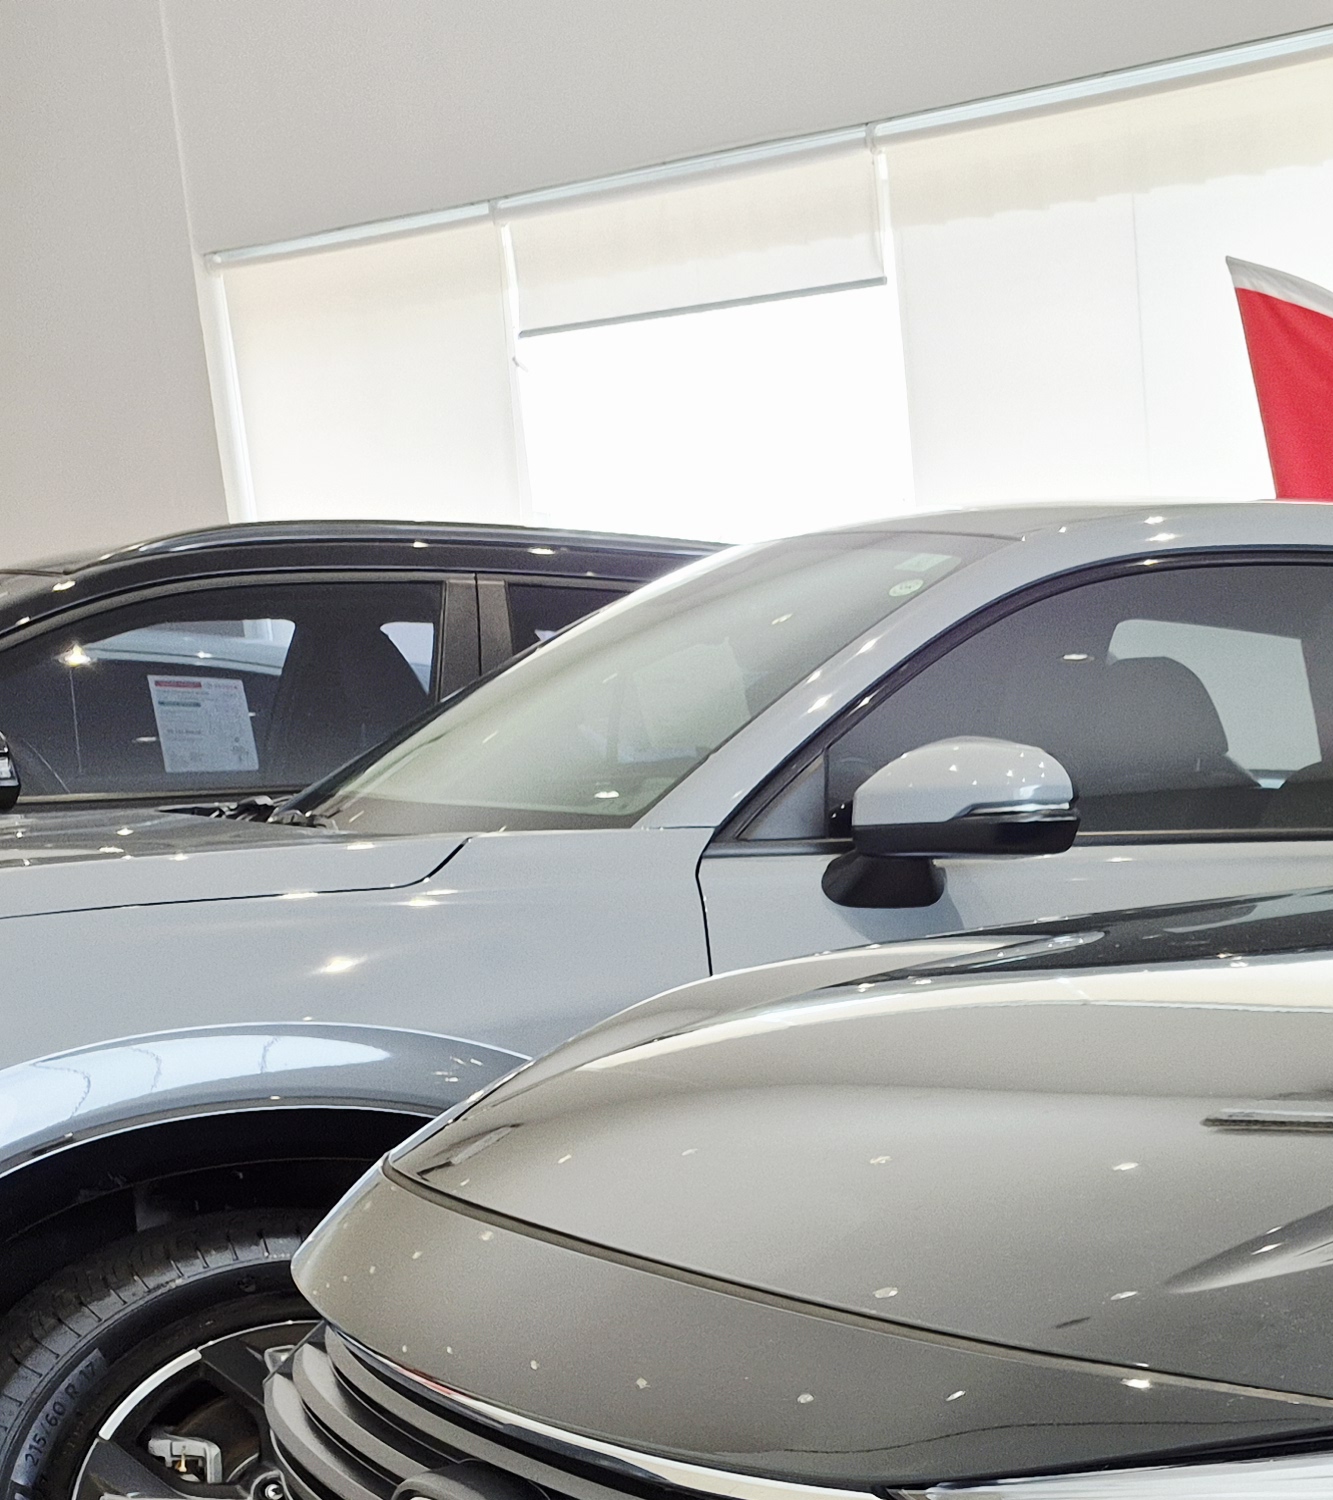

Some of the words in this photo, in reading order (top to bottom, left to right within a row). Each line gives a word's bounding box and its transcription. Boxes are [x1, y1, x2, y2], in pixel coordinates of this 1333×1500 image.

[24, 1400, 67, 1467] 215/60
[64, 1382, 80, 1400] R
[79, 1360, 97, 1381] 17
